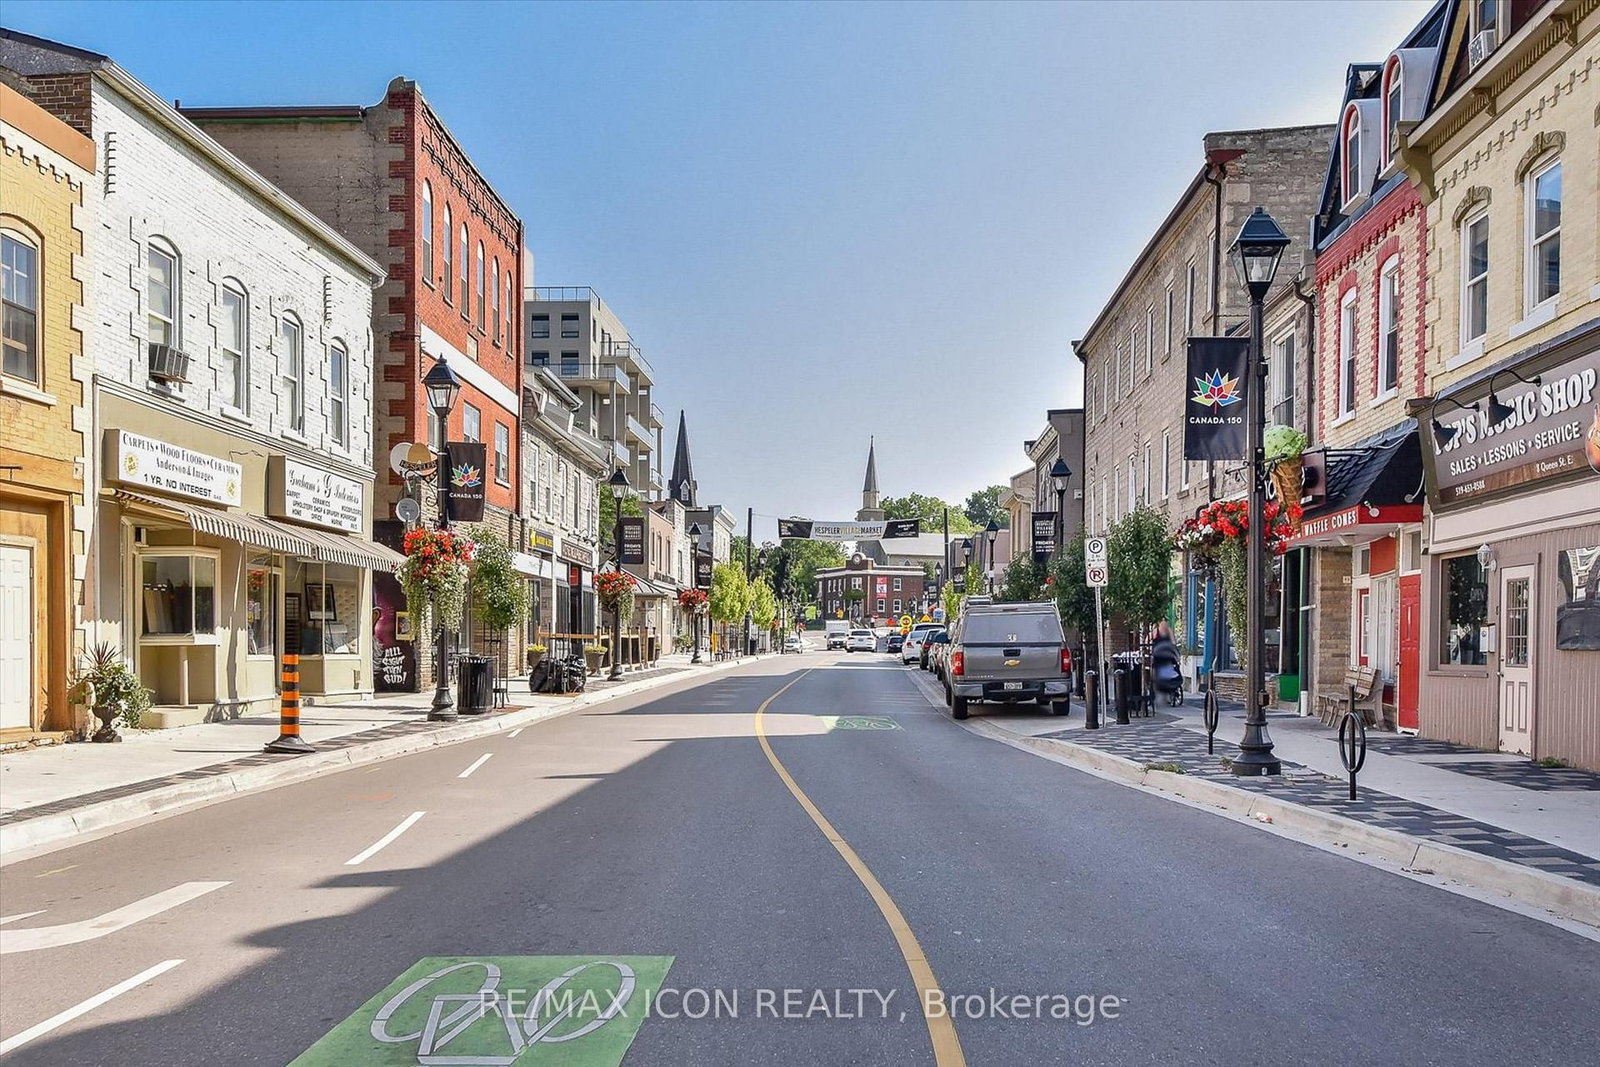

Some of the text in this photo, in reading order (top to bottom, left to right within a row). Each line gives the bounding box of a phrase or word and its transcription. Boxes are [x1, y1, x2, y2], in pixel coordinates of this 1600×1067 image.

[1540, 368, 1597, 418] SHOP
[123, 433, 155, 452] CARPETS
[160, 443, 180, 459] WOOD
[1450, 421, 1581, 476] SALES LESSONS SERVICE
[1540, 460, 1558, 472] Queen
[144, 473, 148, 482] 1
[166, 479, 177, 490] NO
[180, 483, 212, 498] INTEREST
[1304, 510, 1356, 536] WAFFLE CONES
